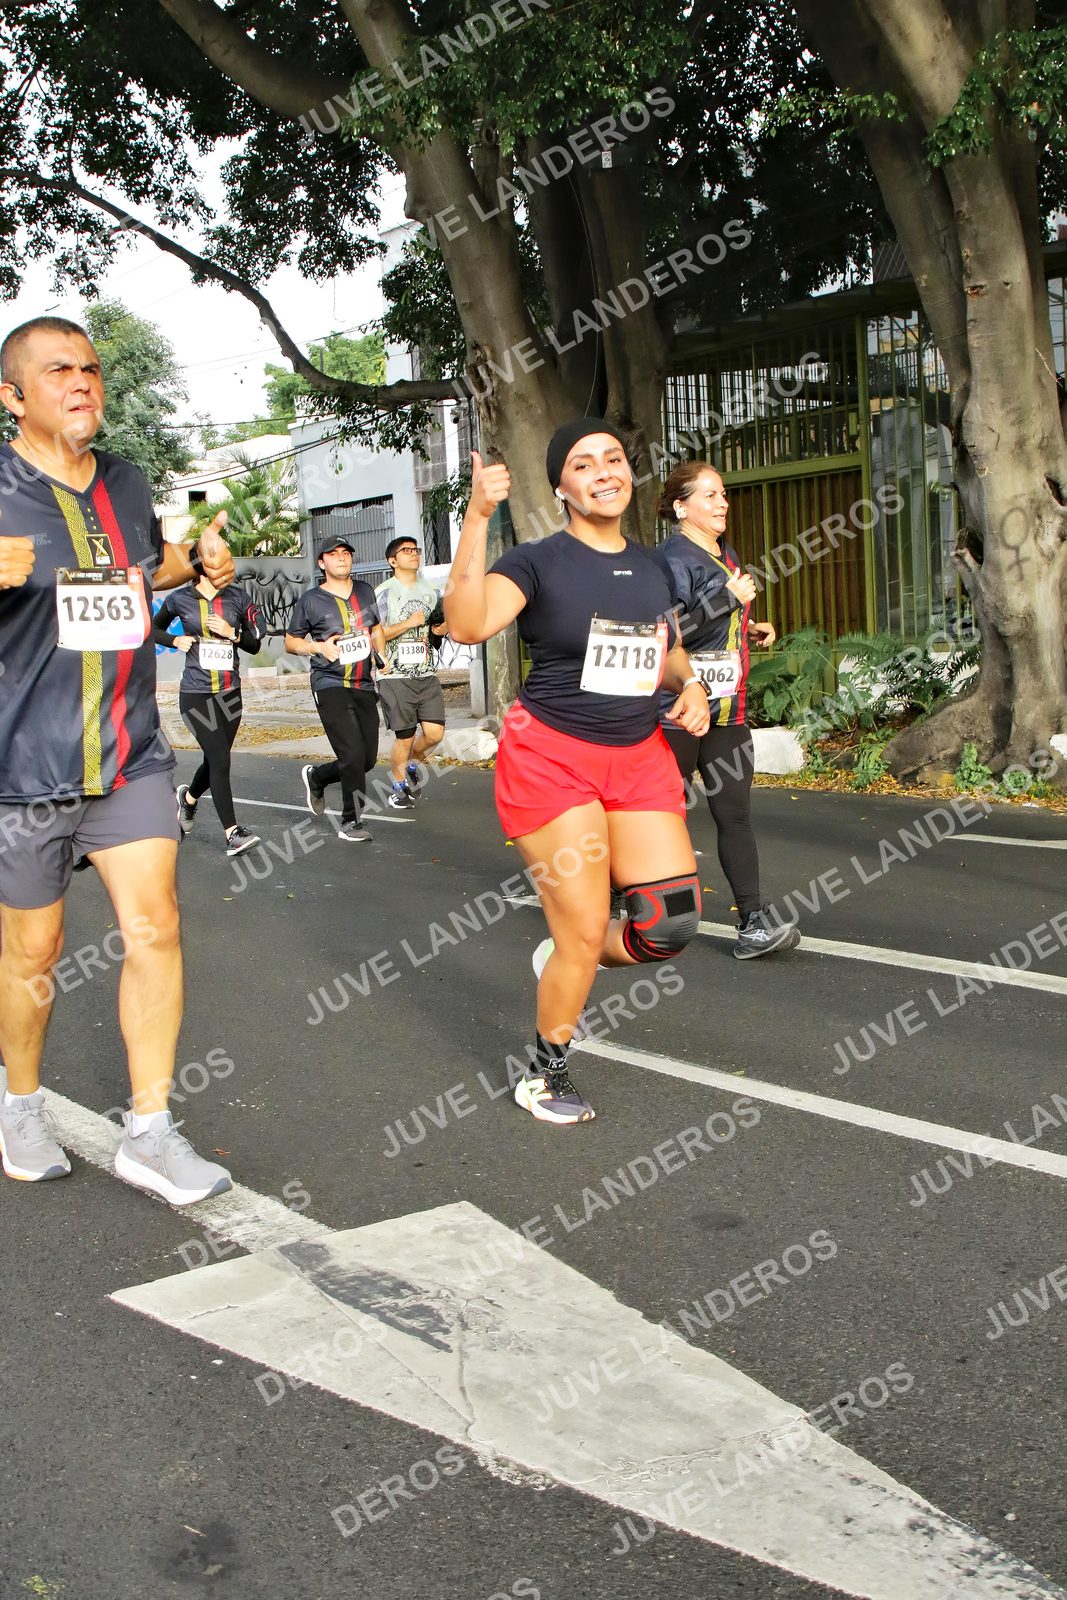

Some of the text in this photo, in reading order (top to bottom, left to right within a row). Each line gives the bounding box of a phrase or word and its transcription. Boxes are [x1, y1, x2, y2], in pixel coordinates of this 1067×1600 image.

[62, 595, 136, 622] 12563
[201, 648, 233, 659] 12628
[340, 639, 367, 654] 10541
[401, 645, 425, 655] 13380
[592, 644, 657, 670] 12118
